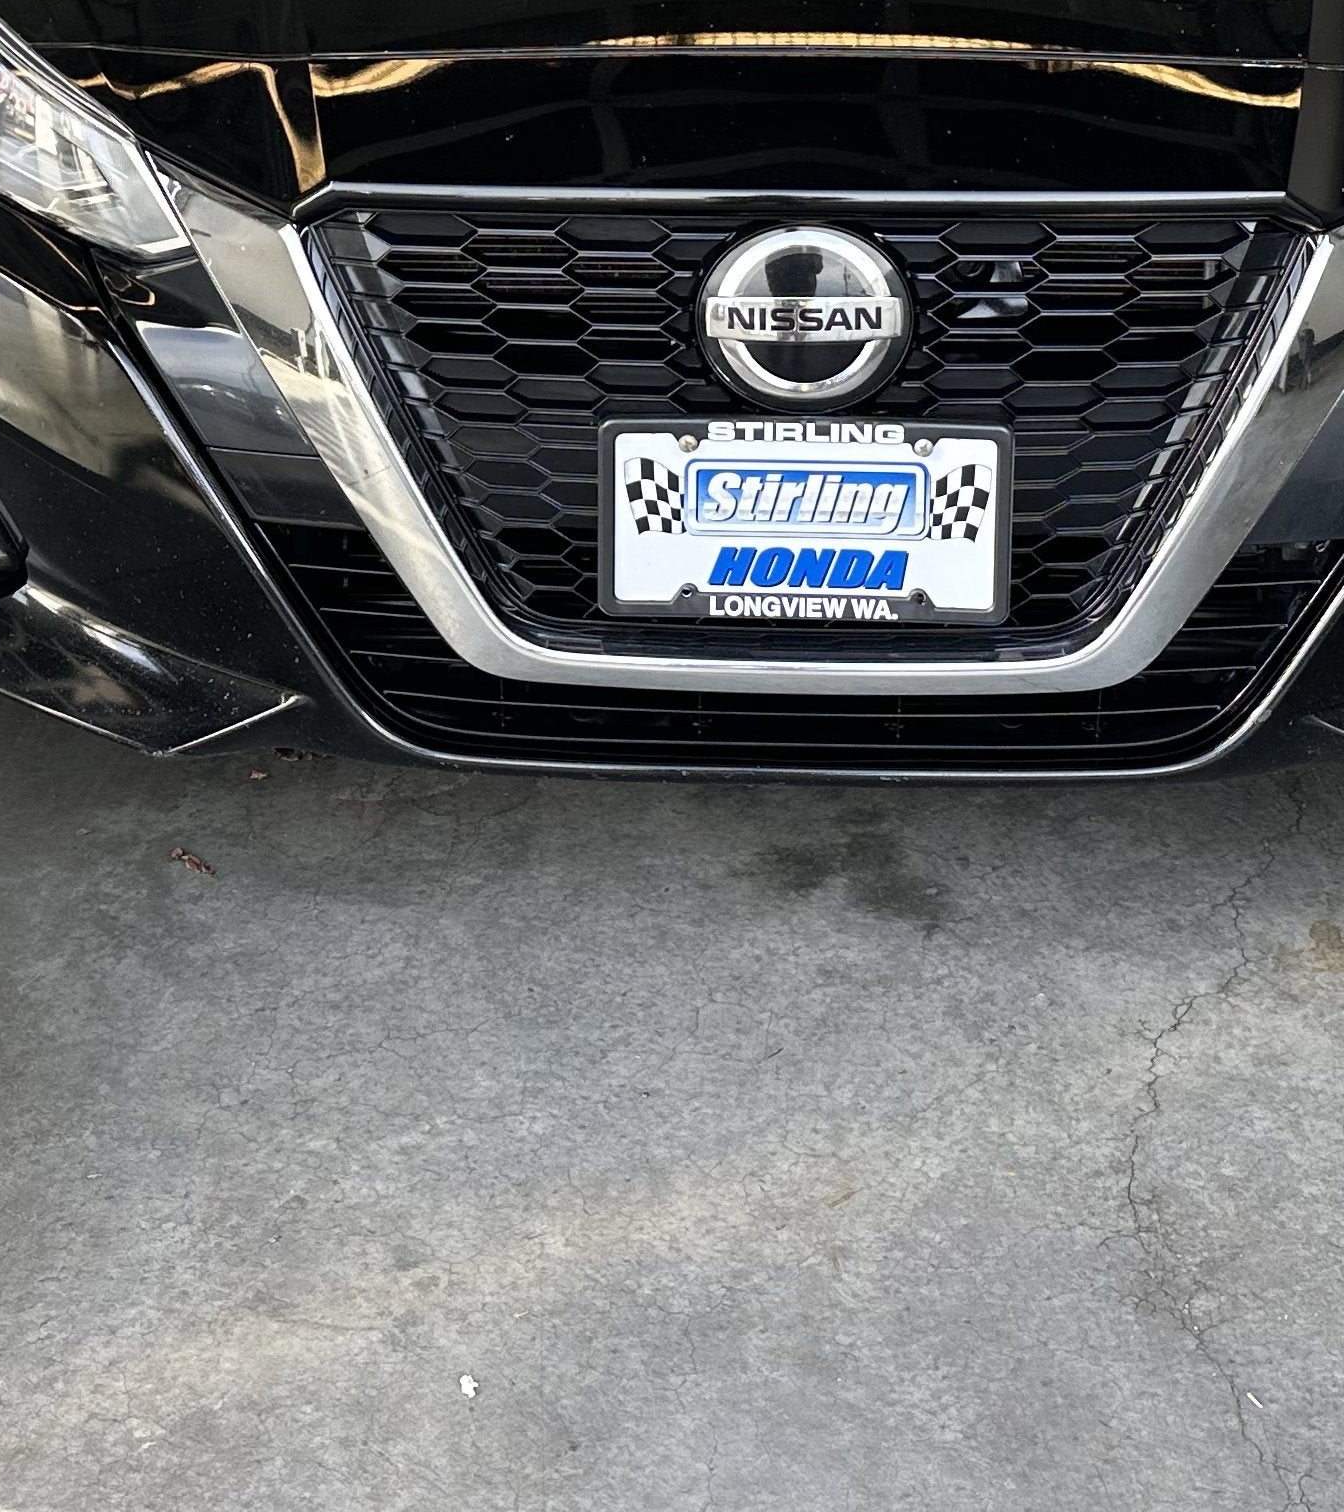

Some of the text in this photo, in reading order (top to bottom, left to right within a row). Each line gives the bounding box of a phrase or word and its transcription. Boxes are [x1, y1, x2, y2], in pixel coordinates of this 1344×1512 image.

[726, 305, 883, 332] NISSAN
[707, 421, 905, 444] STIRLING
[705, 471, 909, 534] Stirling
[707, 546, 910, 591] HONDA
[709, 595, 899, 622] LONGVIEW WA.
